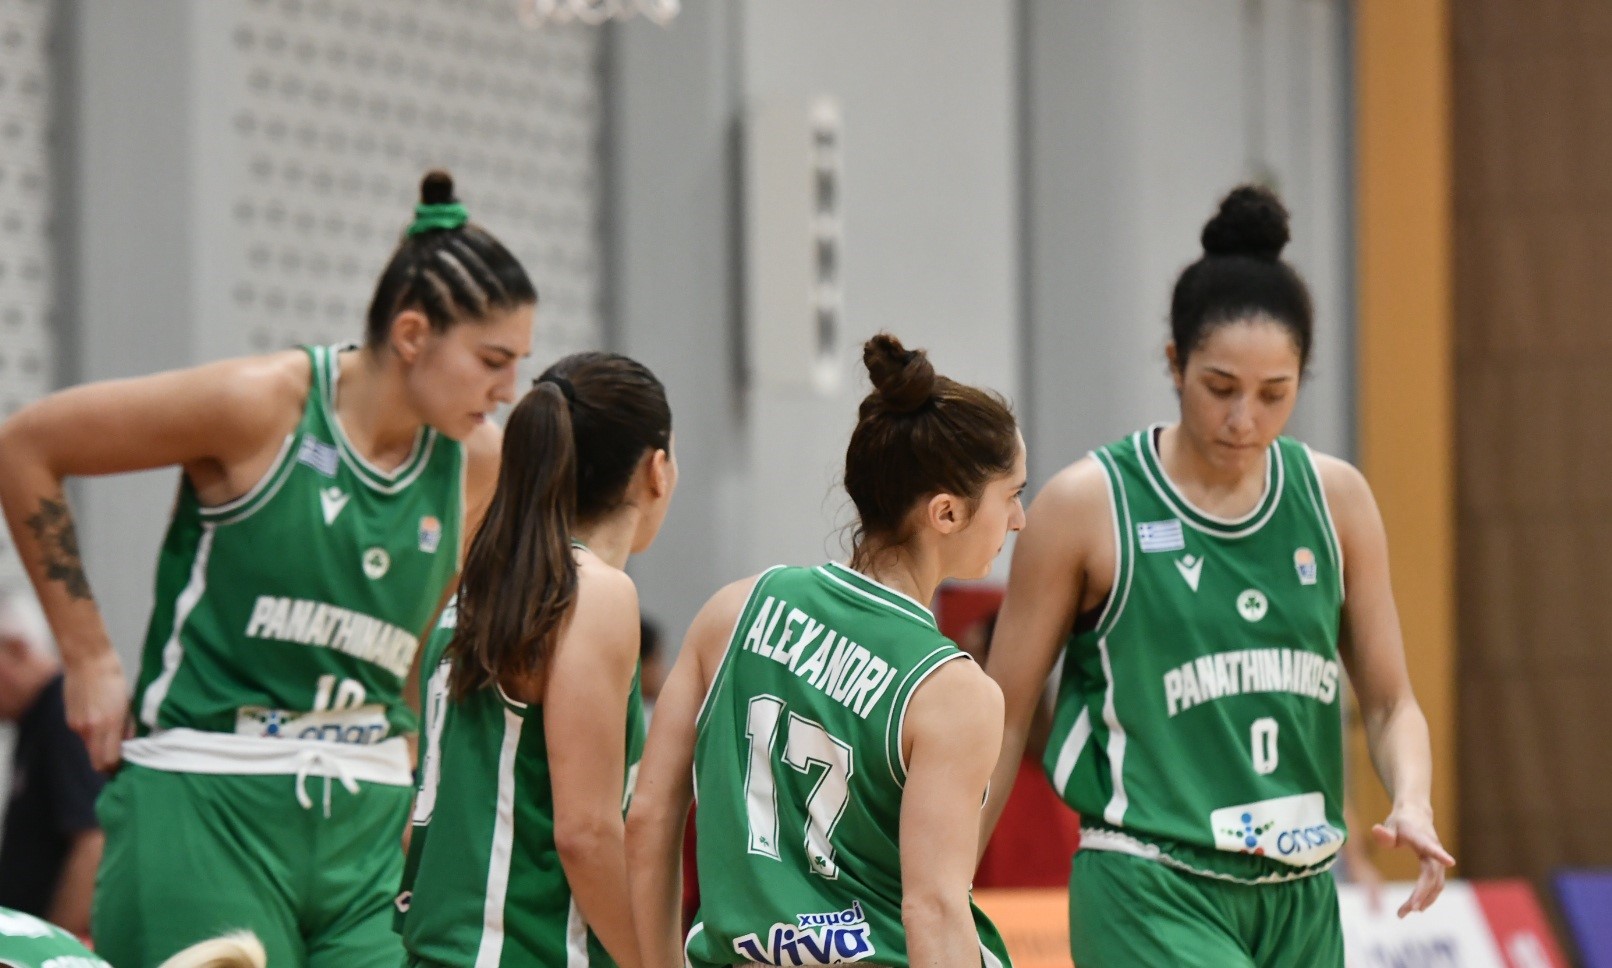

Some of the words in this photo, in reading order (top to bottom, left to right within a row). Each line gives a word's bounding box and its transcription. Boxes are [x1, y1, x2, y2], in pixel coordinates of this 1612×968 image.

[743, 596, 898, 719] ALEXANDRI
[1163, 648, 1339, 719] PANATHINAIKOS
[1251, 716, 1279, 776] 0
[744, 693, 854, 881] 17
[738, 928, 869, 967] Viva
